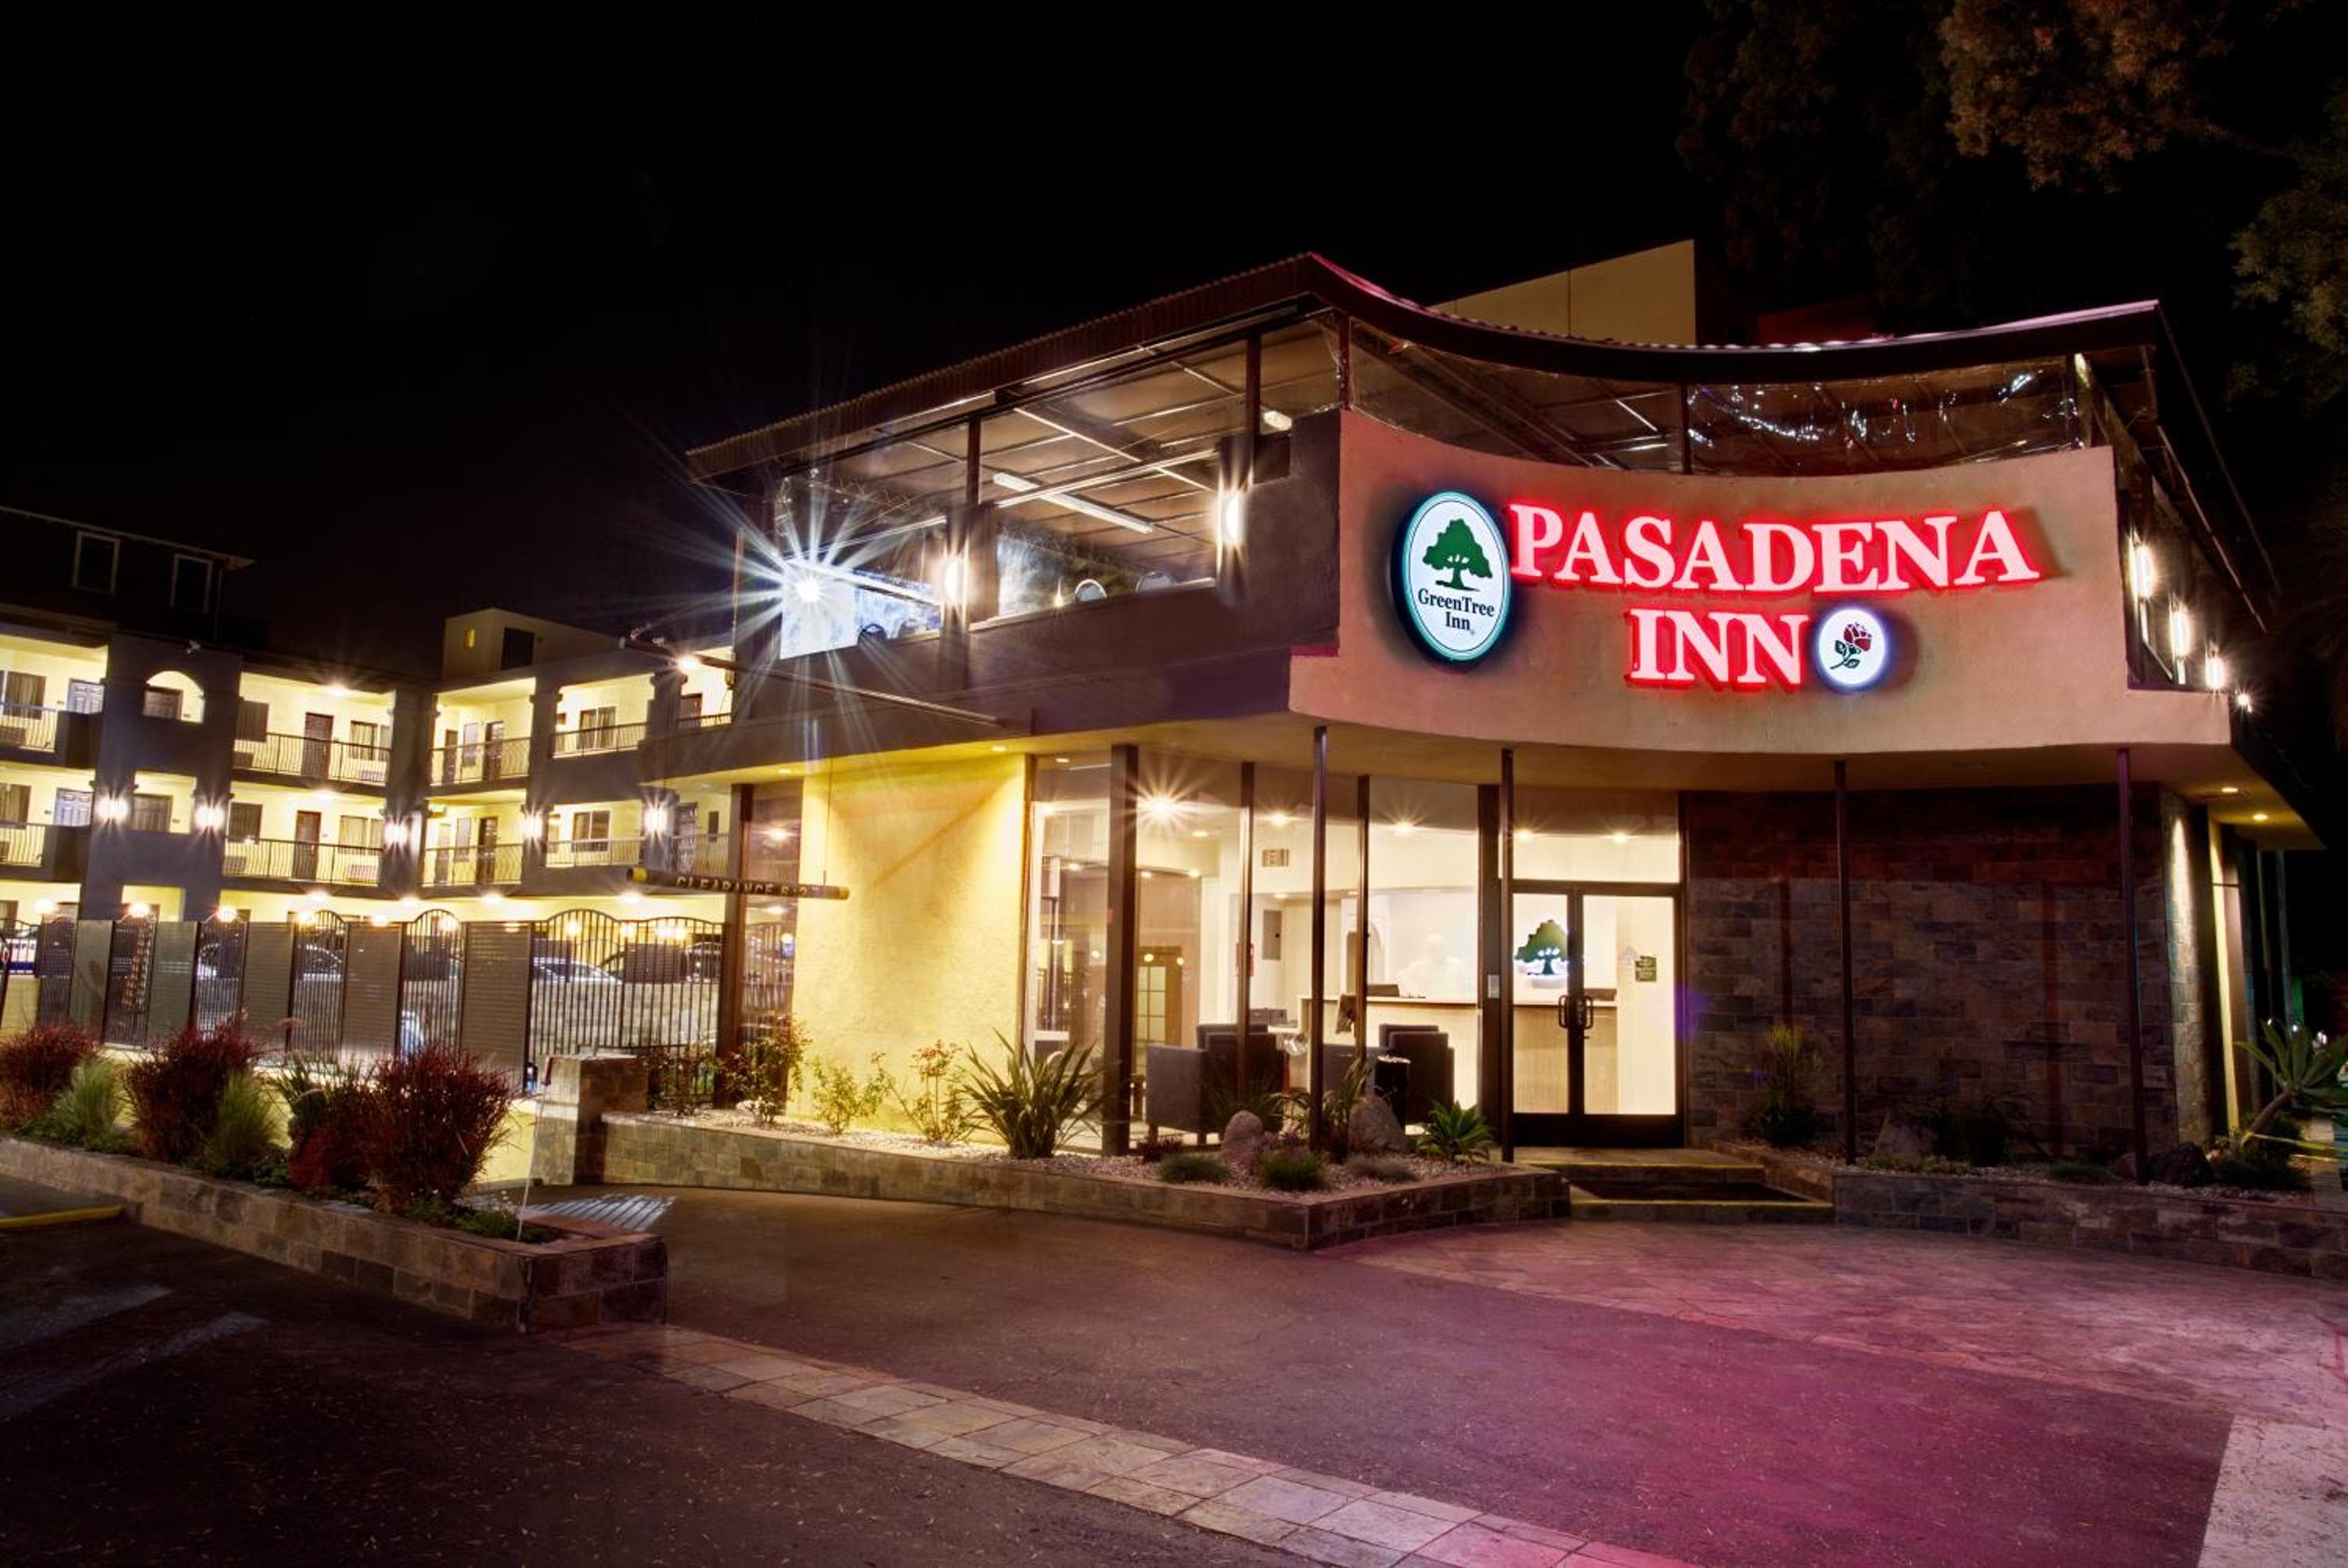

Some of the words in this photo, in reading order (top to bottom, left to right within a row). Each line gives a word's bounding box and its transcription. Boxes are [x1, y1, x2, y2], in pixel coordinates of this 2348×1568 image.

[1510, 503, 2040, 592] PASADENA
[1417, 588, 1496, 617] GreenTree
[1445, 611, 1471, 631] Inn
[1630, 608, 1809, 685] INN
[676, 876, 775, 894] CLEARANCE
